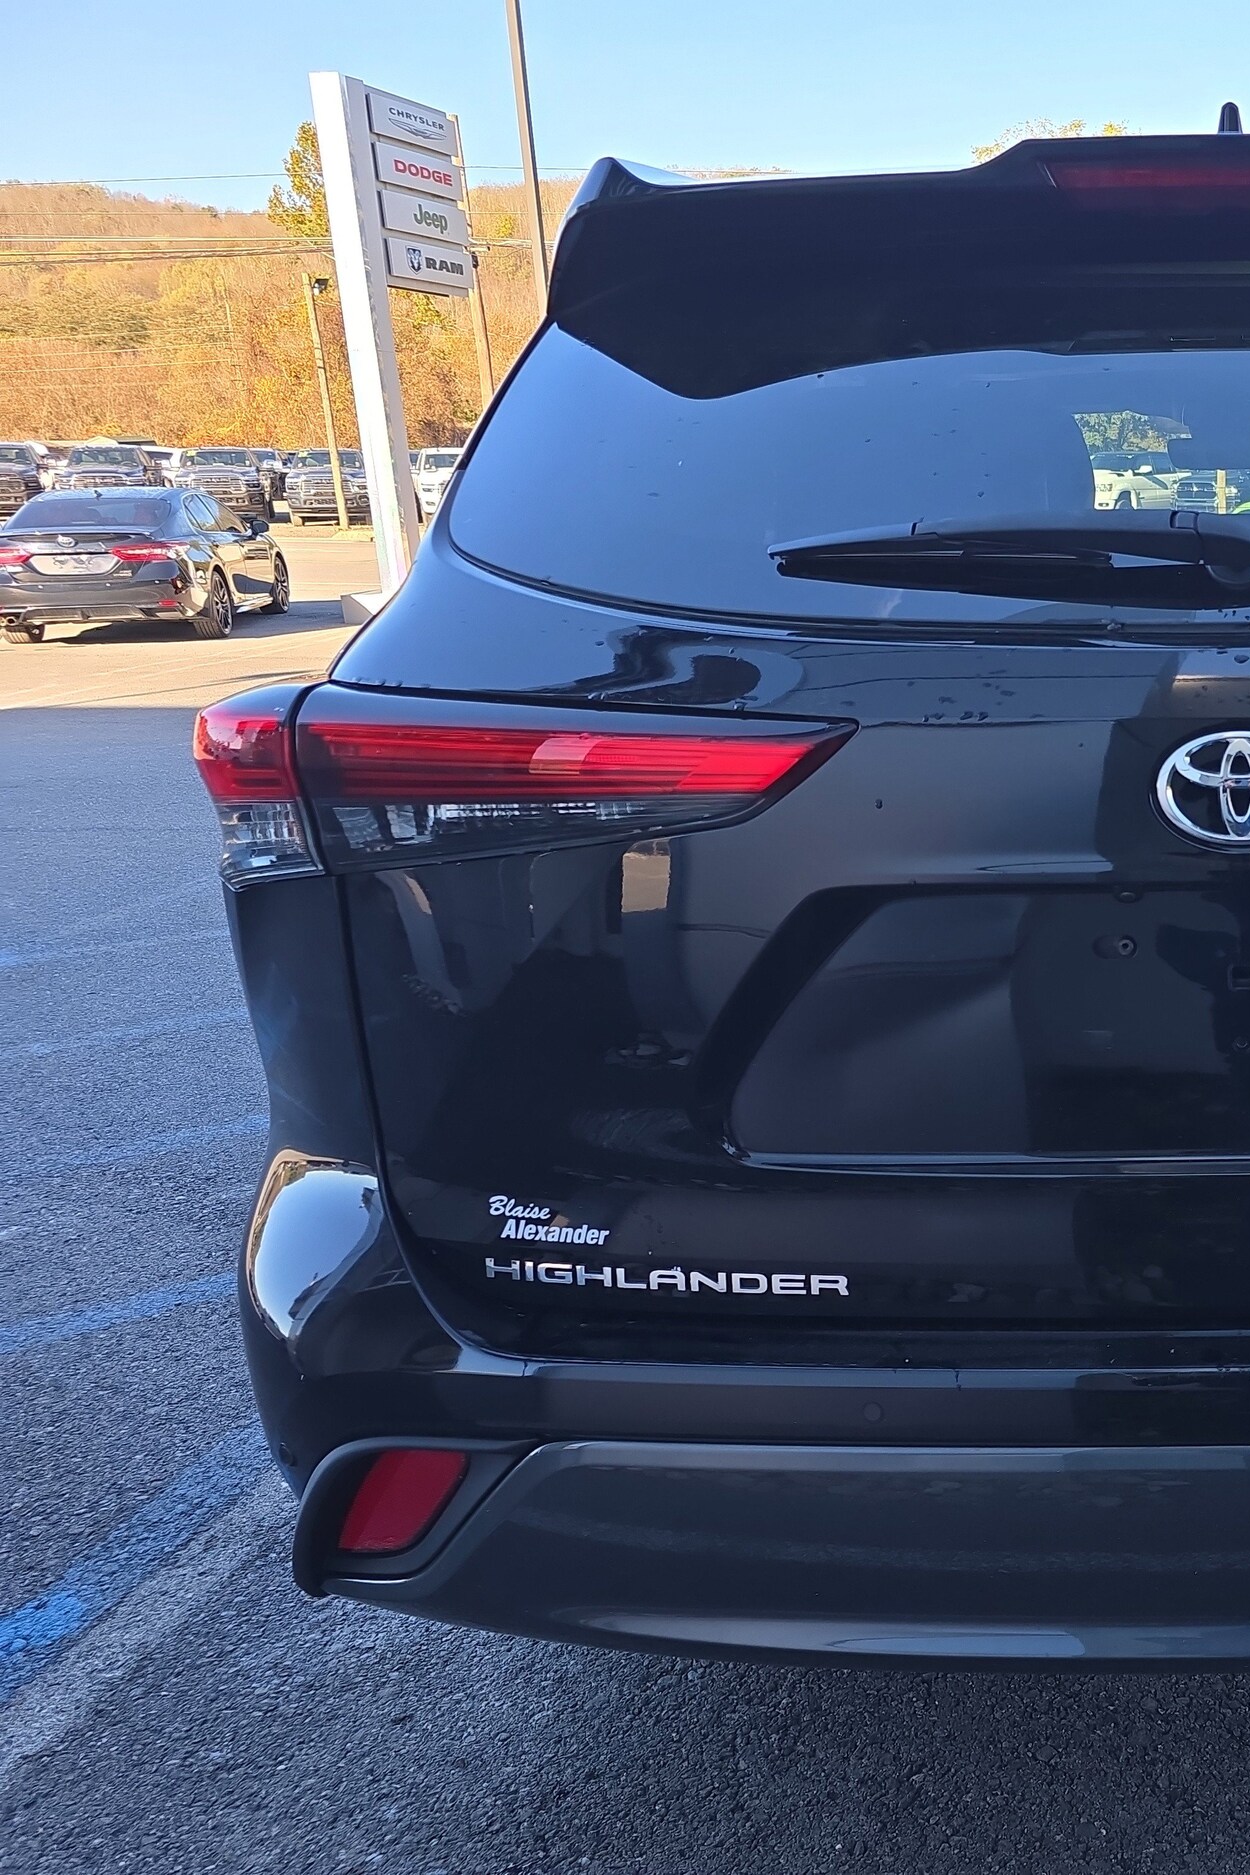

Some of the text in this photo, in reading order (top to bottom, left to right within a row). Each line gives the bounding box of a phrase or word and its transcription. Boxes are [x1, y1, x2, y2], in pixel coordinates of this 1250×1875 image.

[388, 107, 445, 132] CHRYSLER
[393, 159, 453, 187] DODGE
[413, 203, 448, 235] Jeep
[425, 256, 464, 276] RAM
[488, 1195, 552, 1220] Blaise
[500, 1218, 610, 1246] Alexander
[484, 1257, 850, 1296] HIGHLANDER
